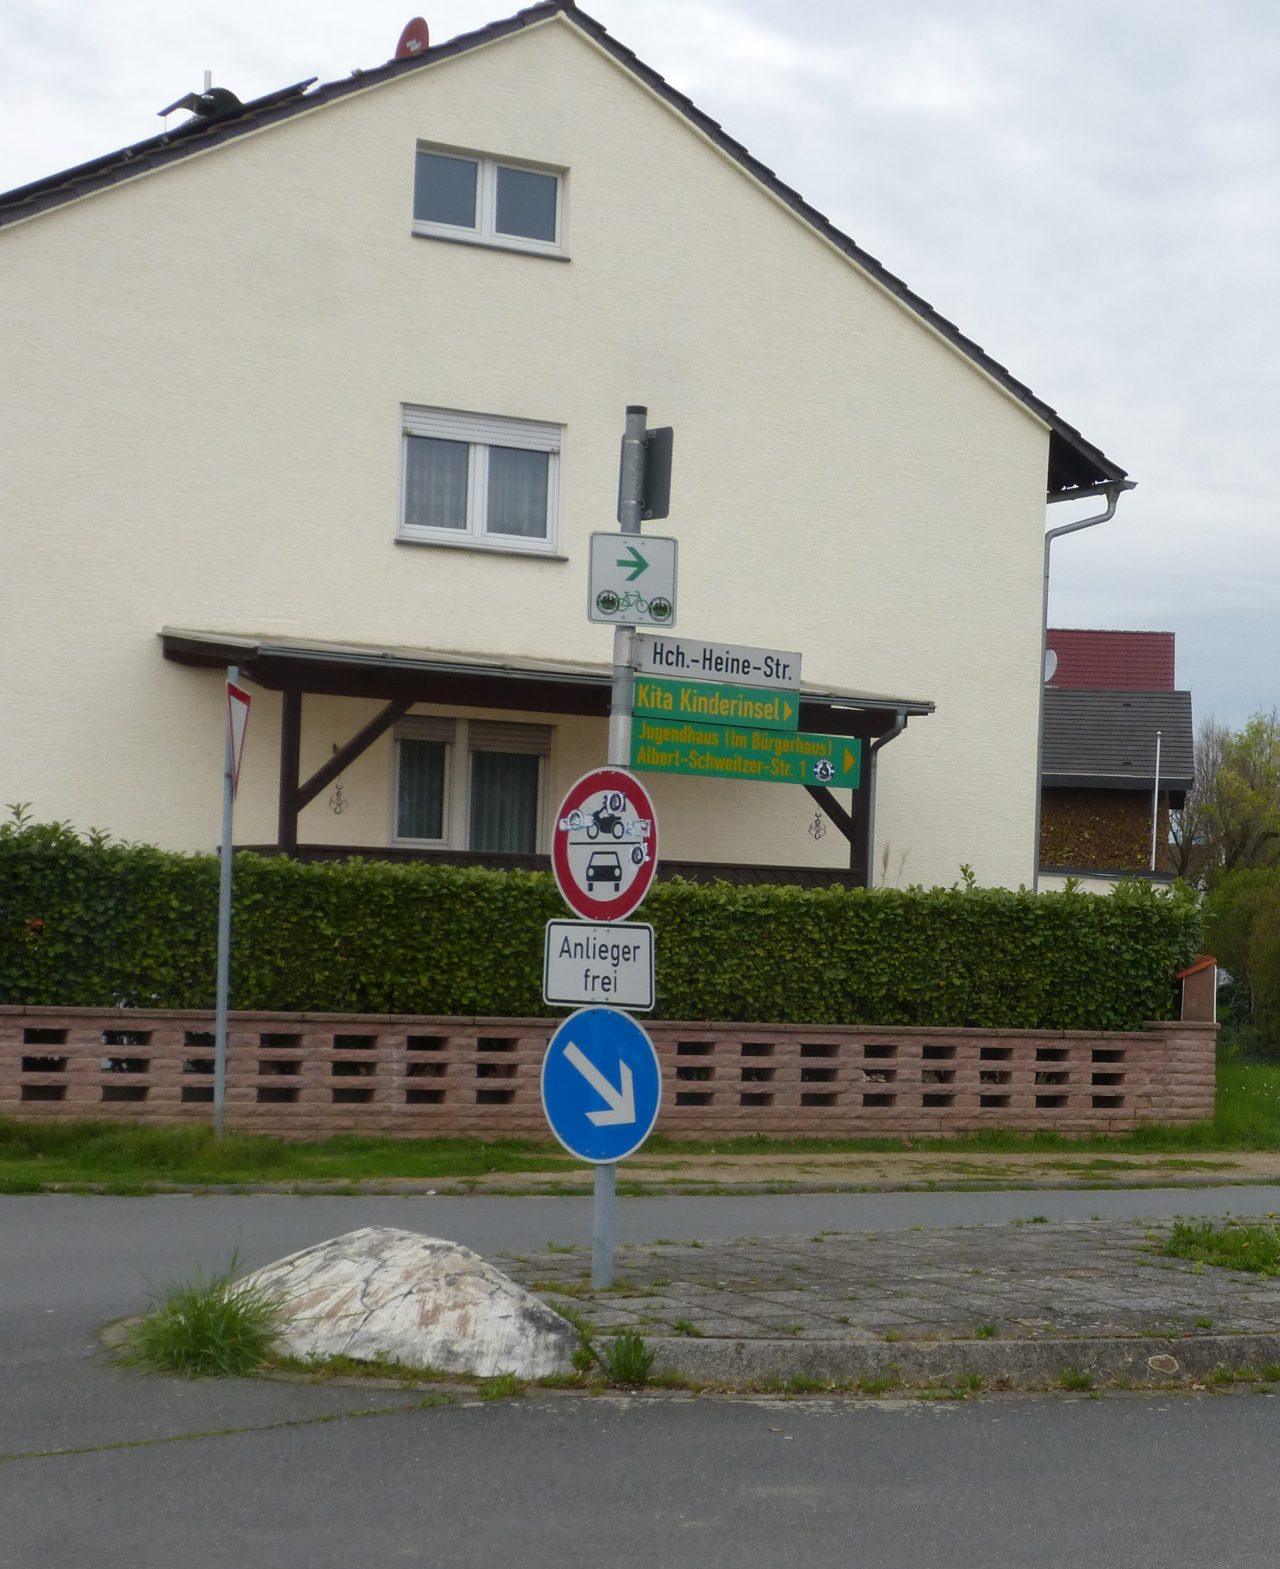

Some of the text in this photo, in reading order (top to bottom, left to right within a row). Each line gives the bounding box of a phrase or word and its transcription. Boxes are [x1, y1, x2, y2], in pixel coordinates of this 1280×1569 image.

[652, 642, 793, 681] Hch.-Heine-Str.
[638, 683, 780, 721] Kita Kinderinsel
[639, 721, 719, 746] Jugendhaus
[751, 731, 832, 757] Bürgerhaus)
[636, 746, 793, 777] Albert-Schweitzer-Str.
[559, 935, 640, 967] Anlieger
[583, 968, 618, 993] frei
